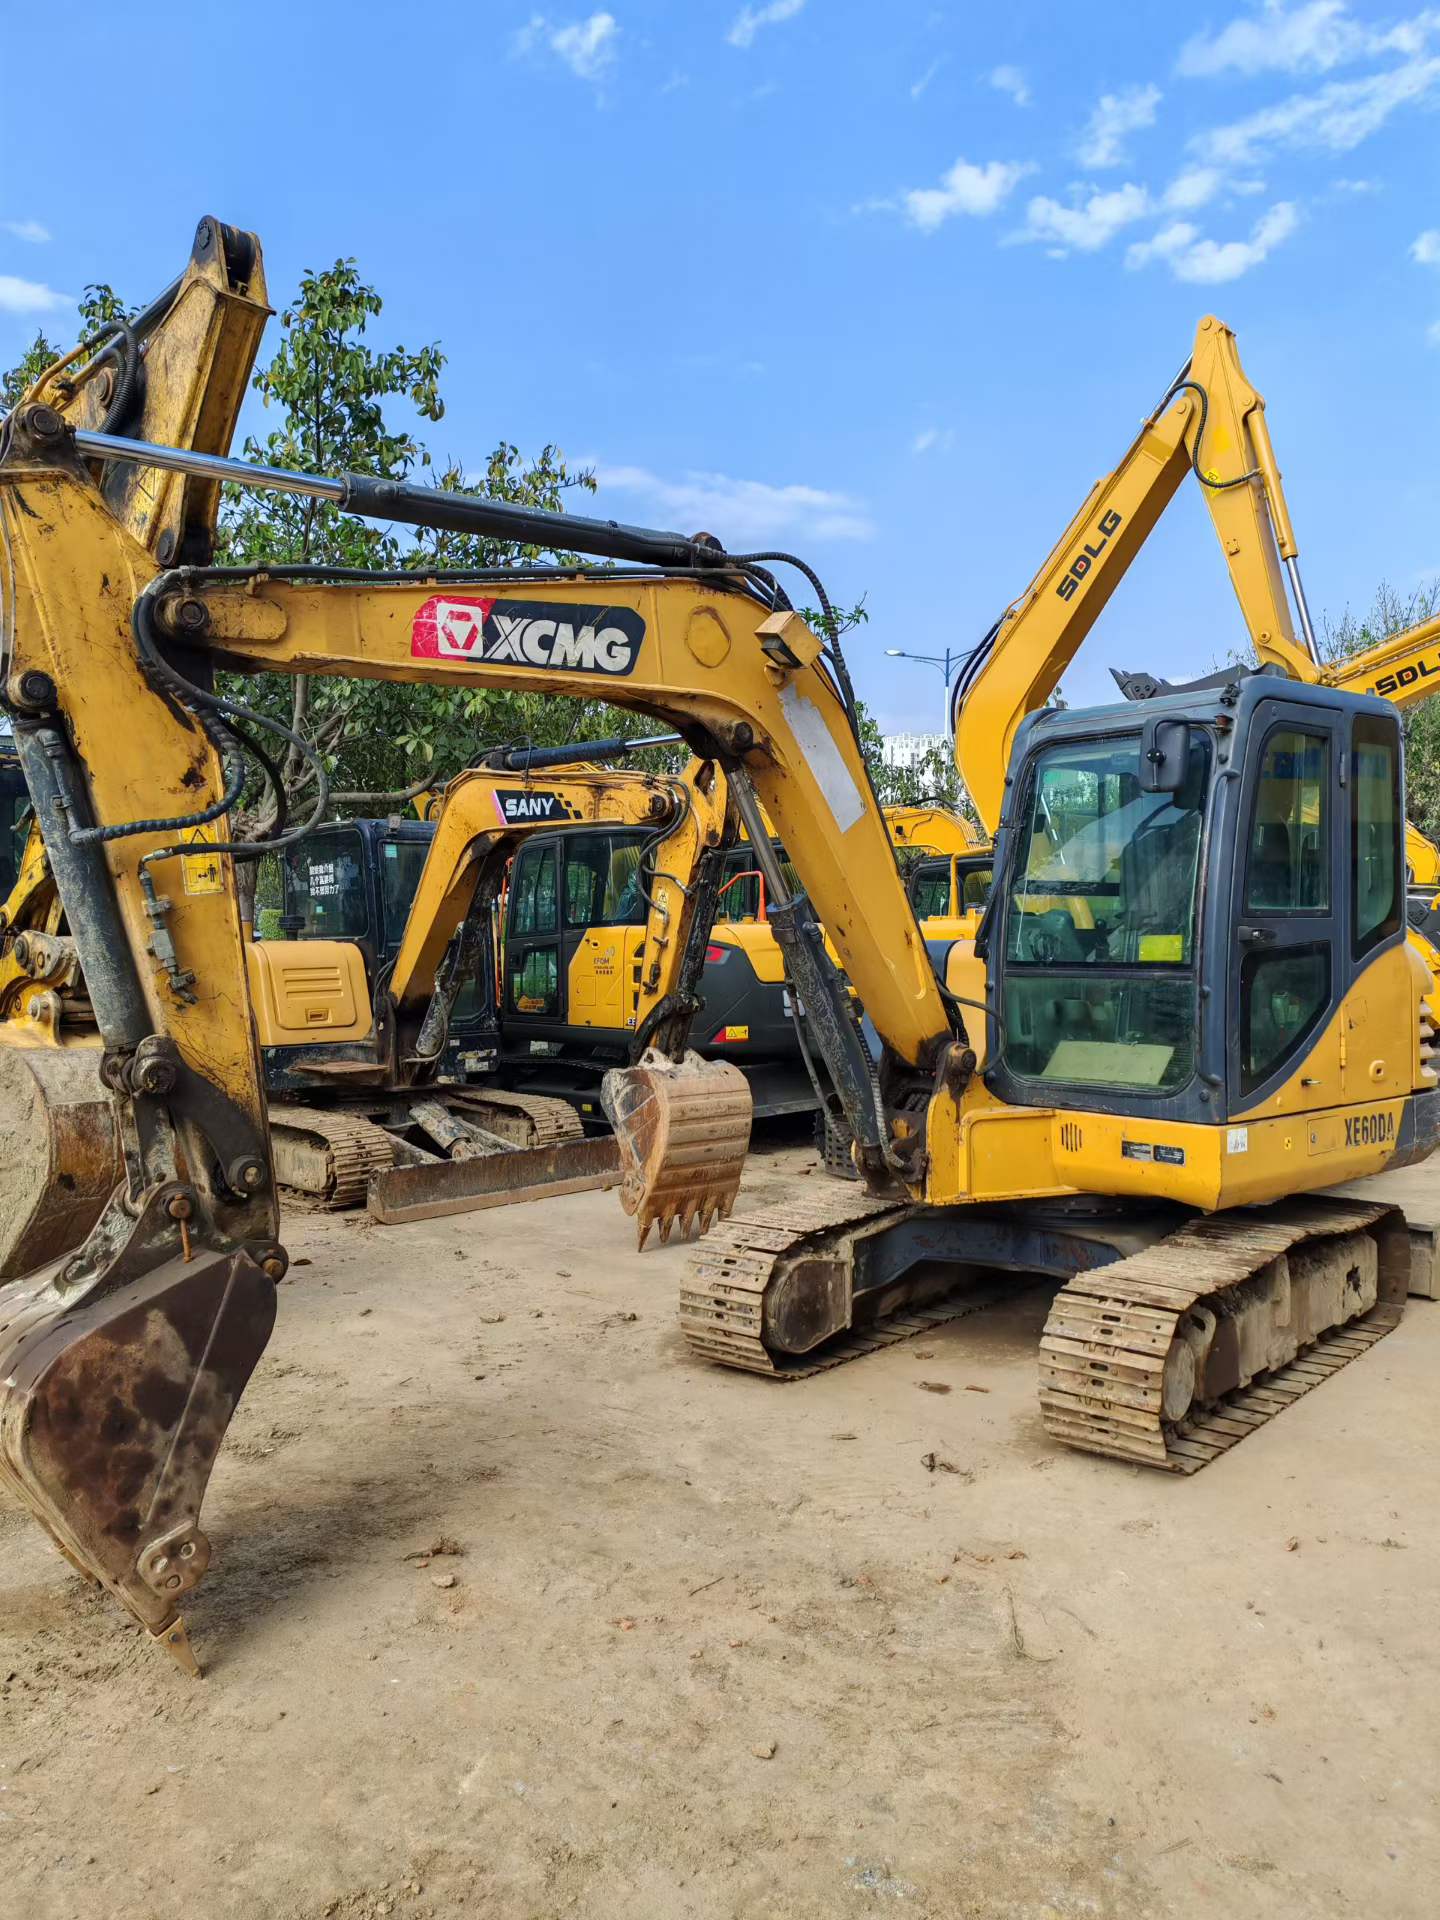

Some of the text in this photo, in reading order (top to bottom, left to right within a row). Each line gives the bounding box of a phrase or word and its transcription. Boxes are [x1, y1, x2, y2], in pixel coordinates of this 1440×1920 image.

[1056, 509, 1122, 602] SDLG
[484, 614, 632, 672] XCMG
[1375, 652, 1440, 696] SDL
[505, 798, 554, 817] SANY
[1344, 1112, 1395, 1146] XE60DA
